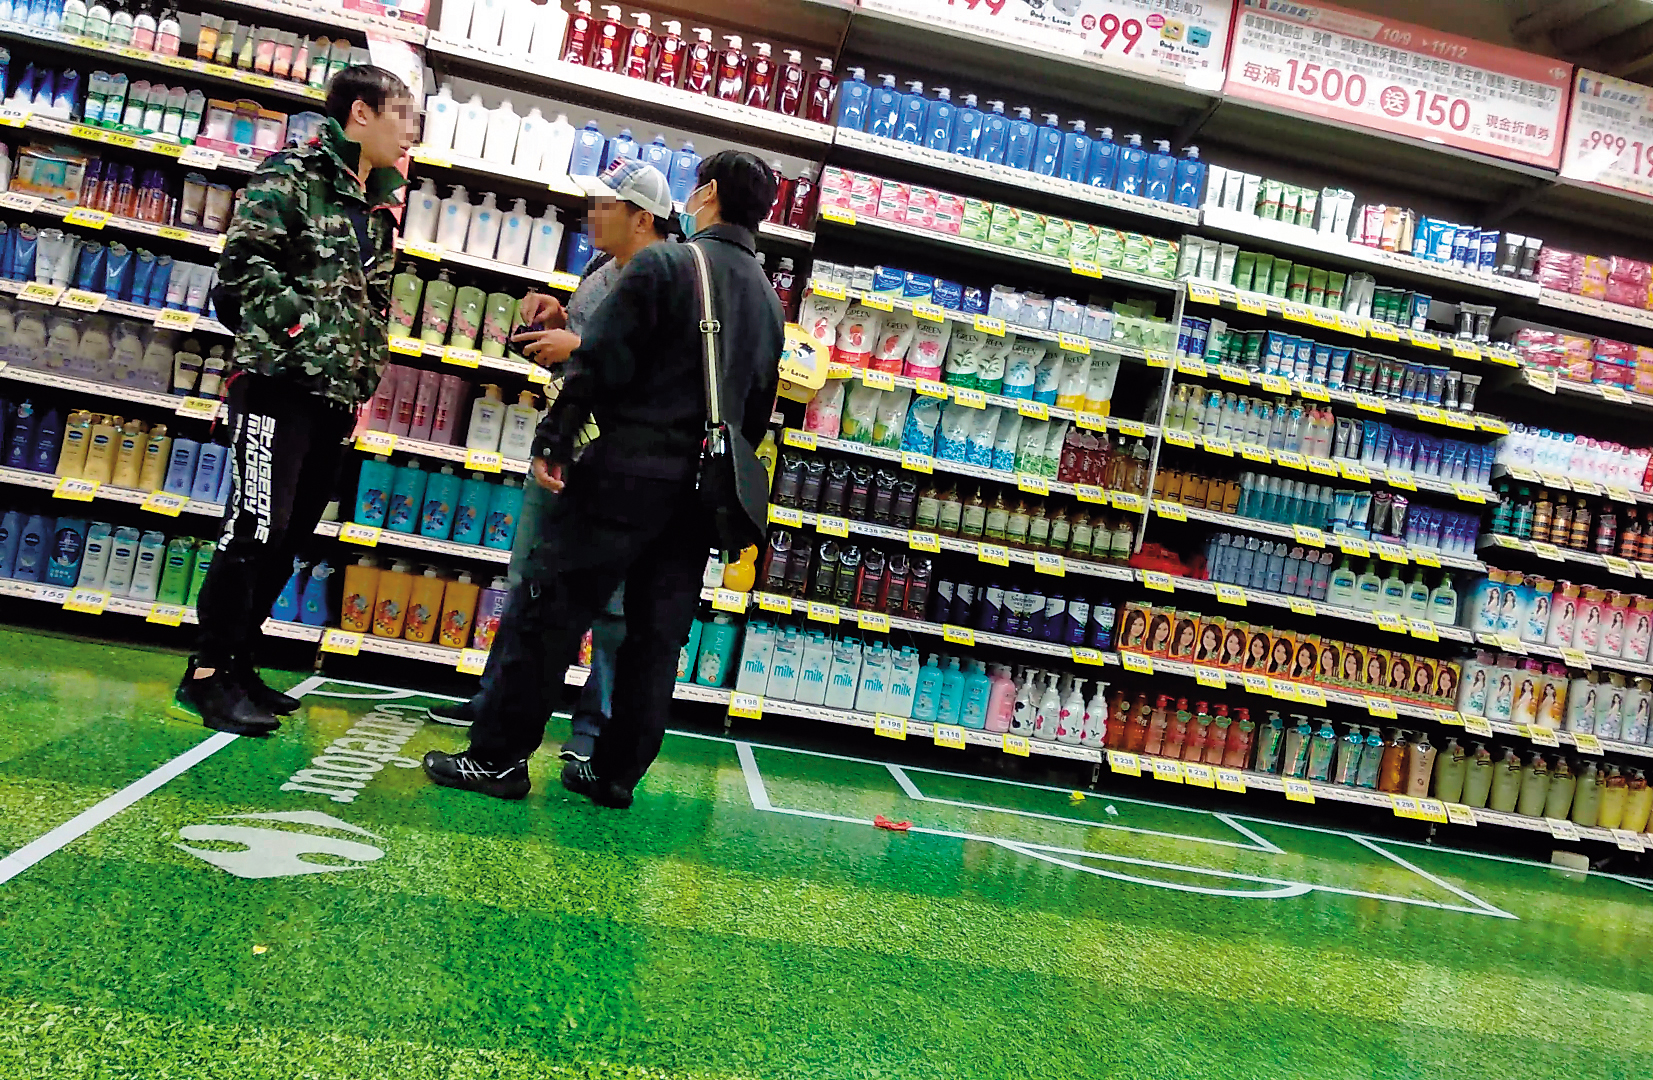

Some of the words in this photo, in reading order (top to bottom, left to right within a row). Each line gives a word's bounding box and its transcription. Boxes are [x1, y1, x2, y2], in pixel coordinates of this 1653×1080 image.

[1100, 13, 1143, 56] 99
[1383, 27, 1412, 47] 10/9
[1432, 39, 1468, 59] 11/12
[1243, 61, 1281, 87] 每滿
[1286, 58, 1367, 108] 1500
[1382, 88, 1410, 116] 送
[1414, 88, 1471, 132] 150
[1590, 129, 1627, 158] 999
[918, 323, 942, 334] GREEN
[956, 332, 979, 342] GREEN
[1013, 344, 1036, 355] GREEN
[243, 413, 261, 515] MADEBY
[254, 414, 277, 545] STAGEONE
[42, 590, 64, 598] 155
[724, 594, 739, 602] 192
[745, 660, 765, 674] milk
[774, 664, 794, 679] milk
[804, 667, 824, 683] milk
[833, 672, 852, 687] milk
[864, 677, 883, 692] milk
[892, 681, 911, 697] milk
[743, 698, 758, 706] 198
[887, 720, 901, 728] 198
[1162, 765, 1176, 773] 238
